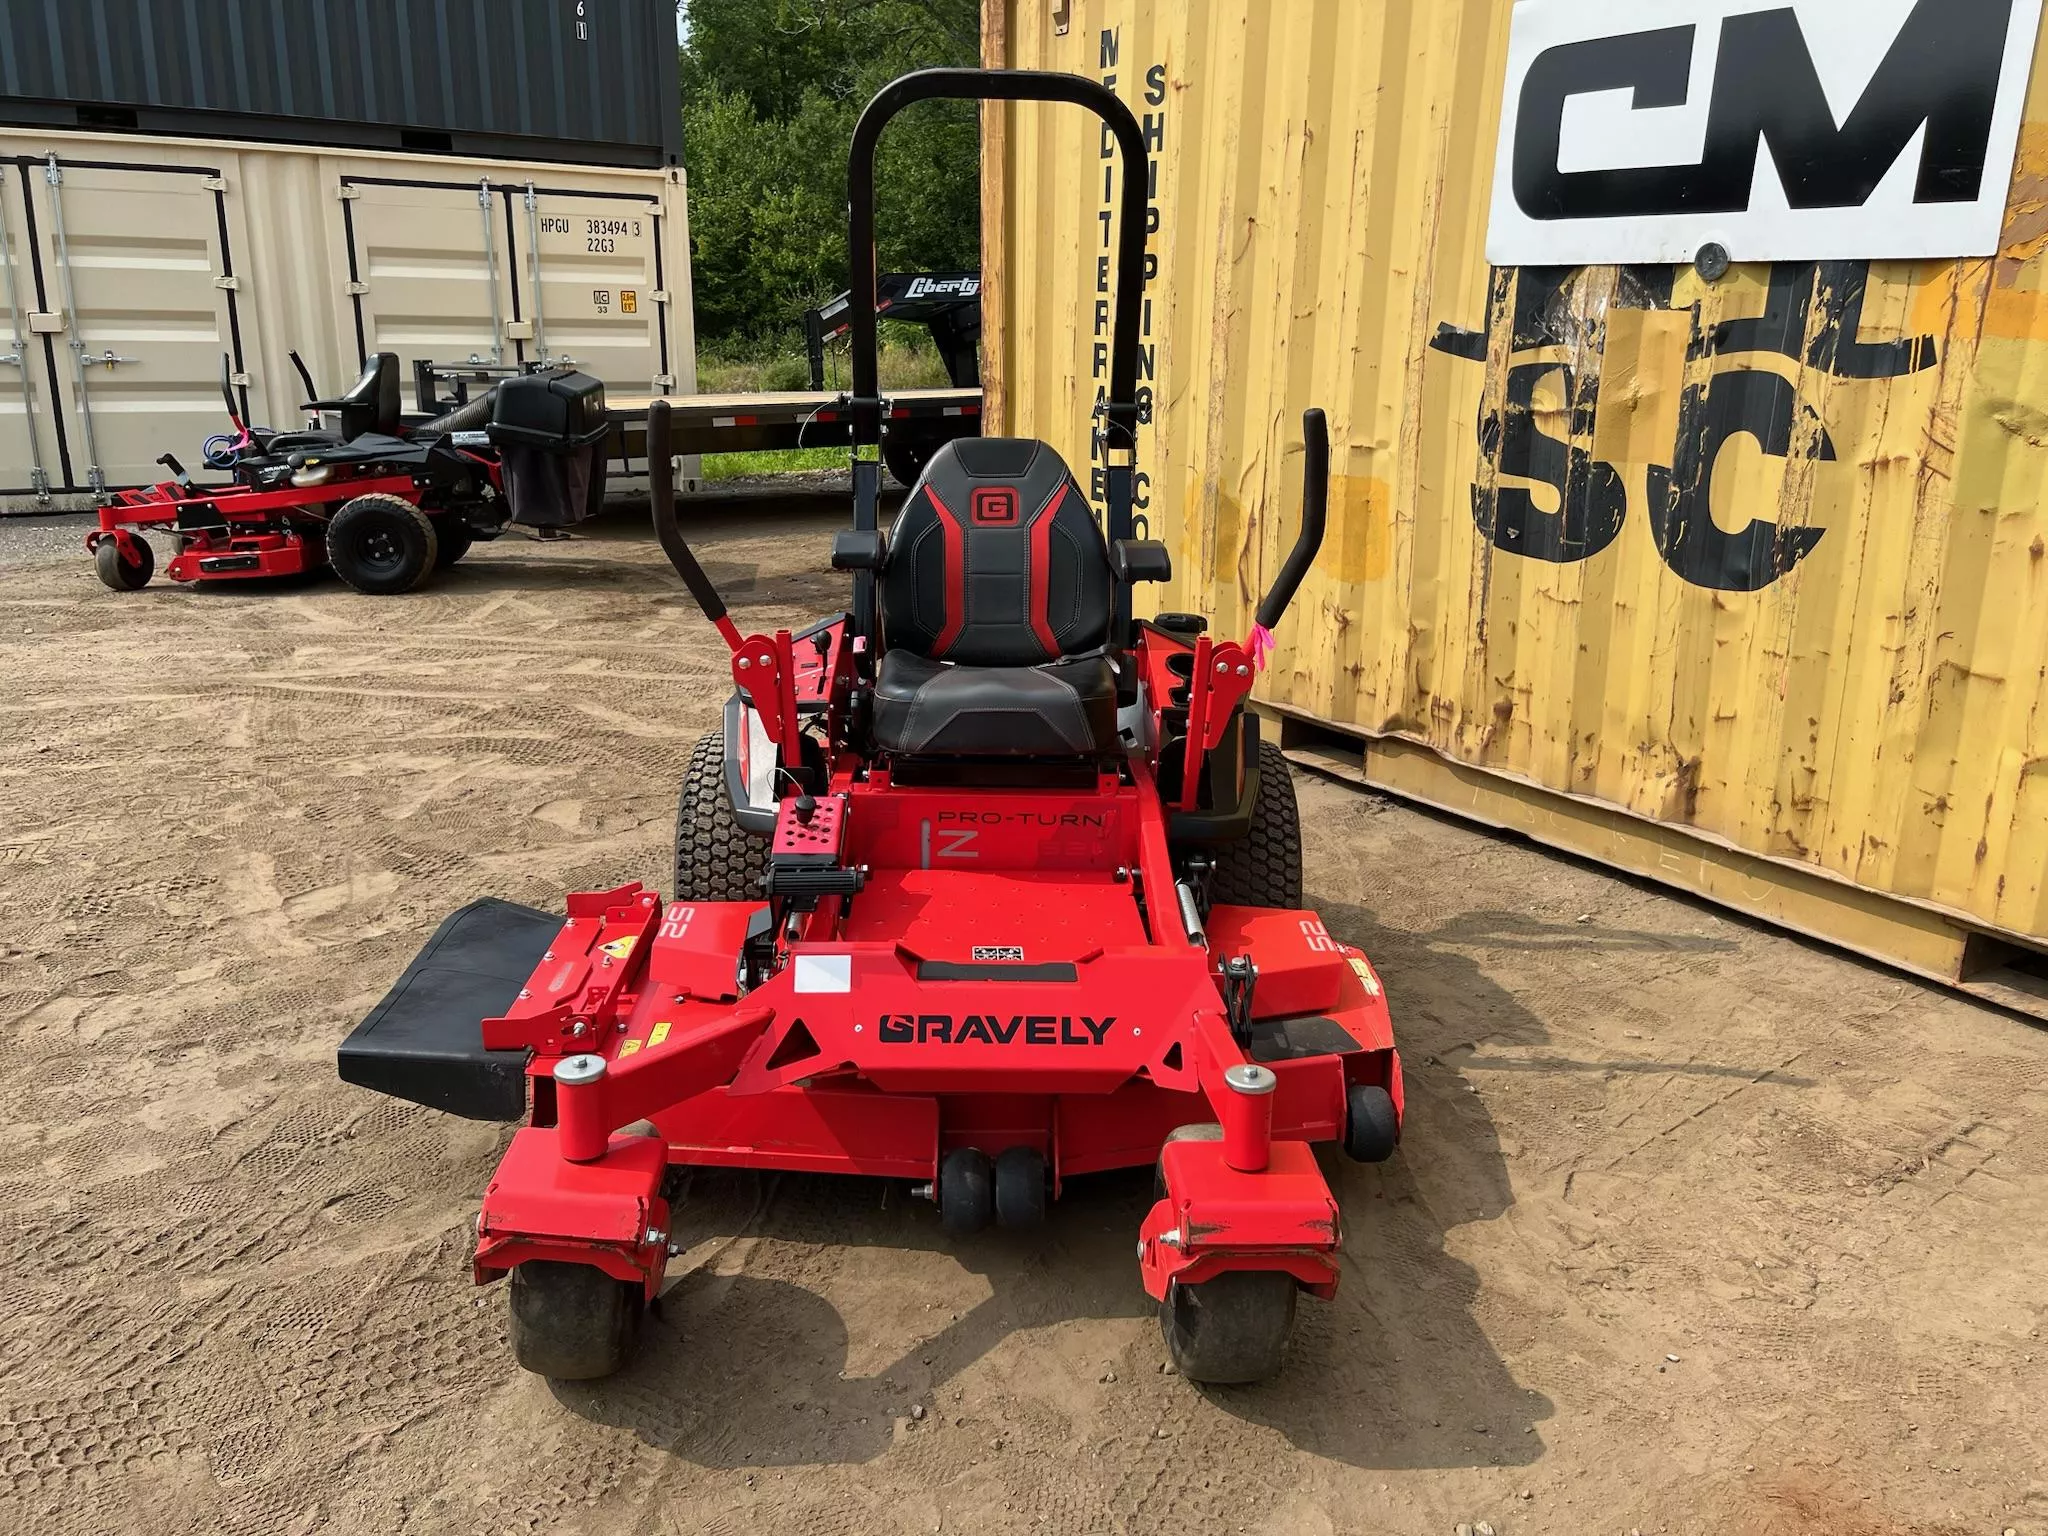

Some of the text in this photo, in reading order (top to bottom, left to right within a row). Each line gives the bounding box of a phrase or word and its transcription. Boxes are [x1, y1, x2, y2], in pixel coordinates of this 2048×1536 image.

[576, 1, 585, 17] 6
[1512, 0, 2012, 221] CM
[541, 218, 569, 233] HPGU
[586, 219, 628, 236] 383494
[587, 238, 615, 253] 22G3
[904, 277, 980, 298] Liberty
[597, 306, 608, 314] 33
[938, 811, 1104, 828] PRO-TURN
[937, 830, 979, 857] Z
[879, 1014, 1118, 1046] GRAVELY
